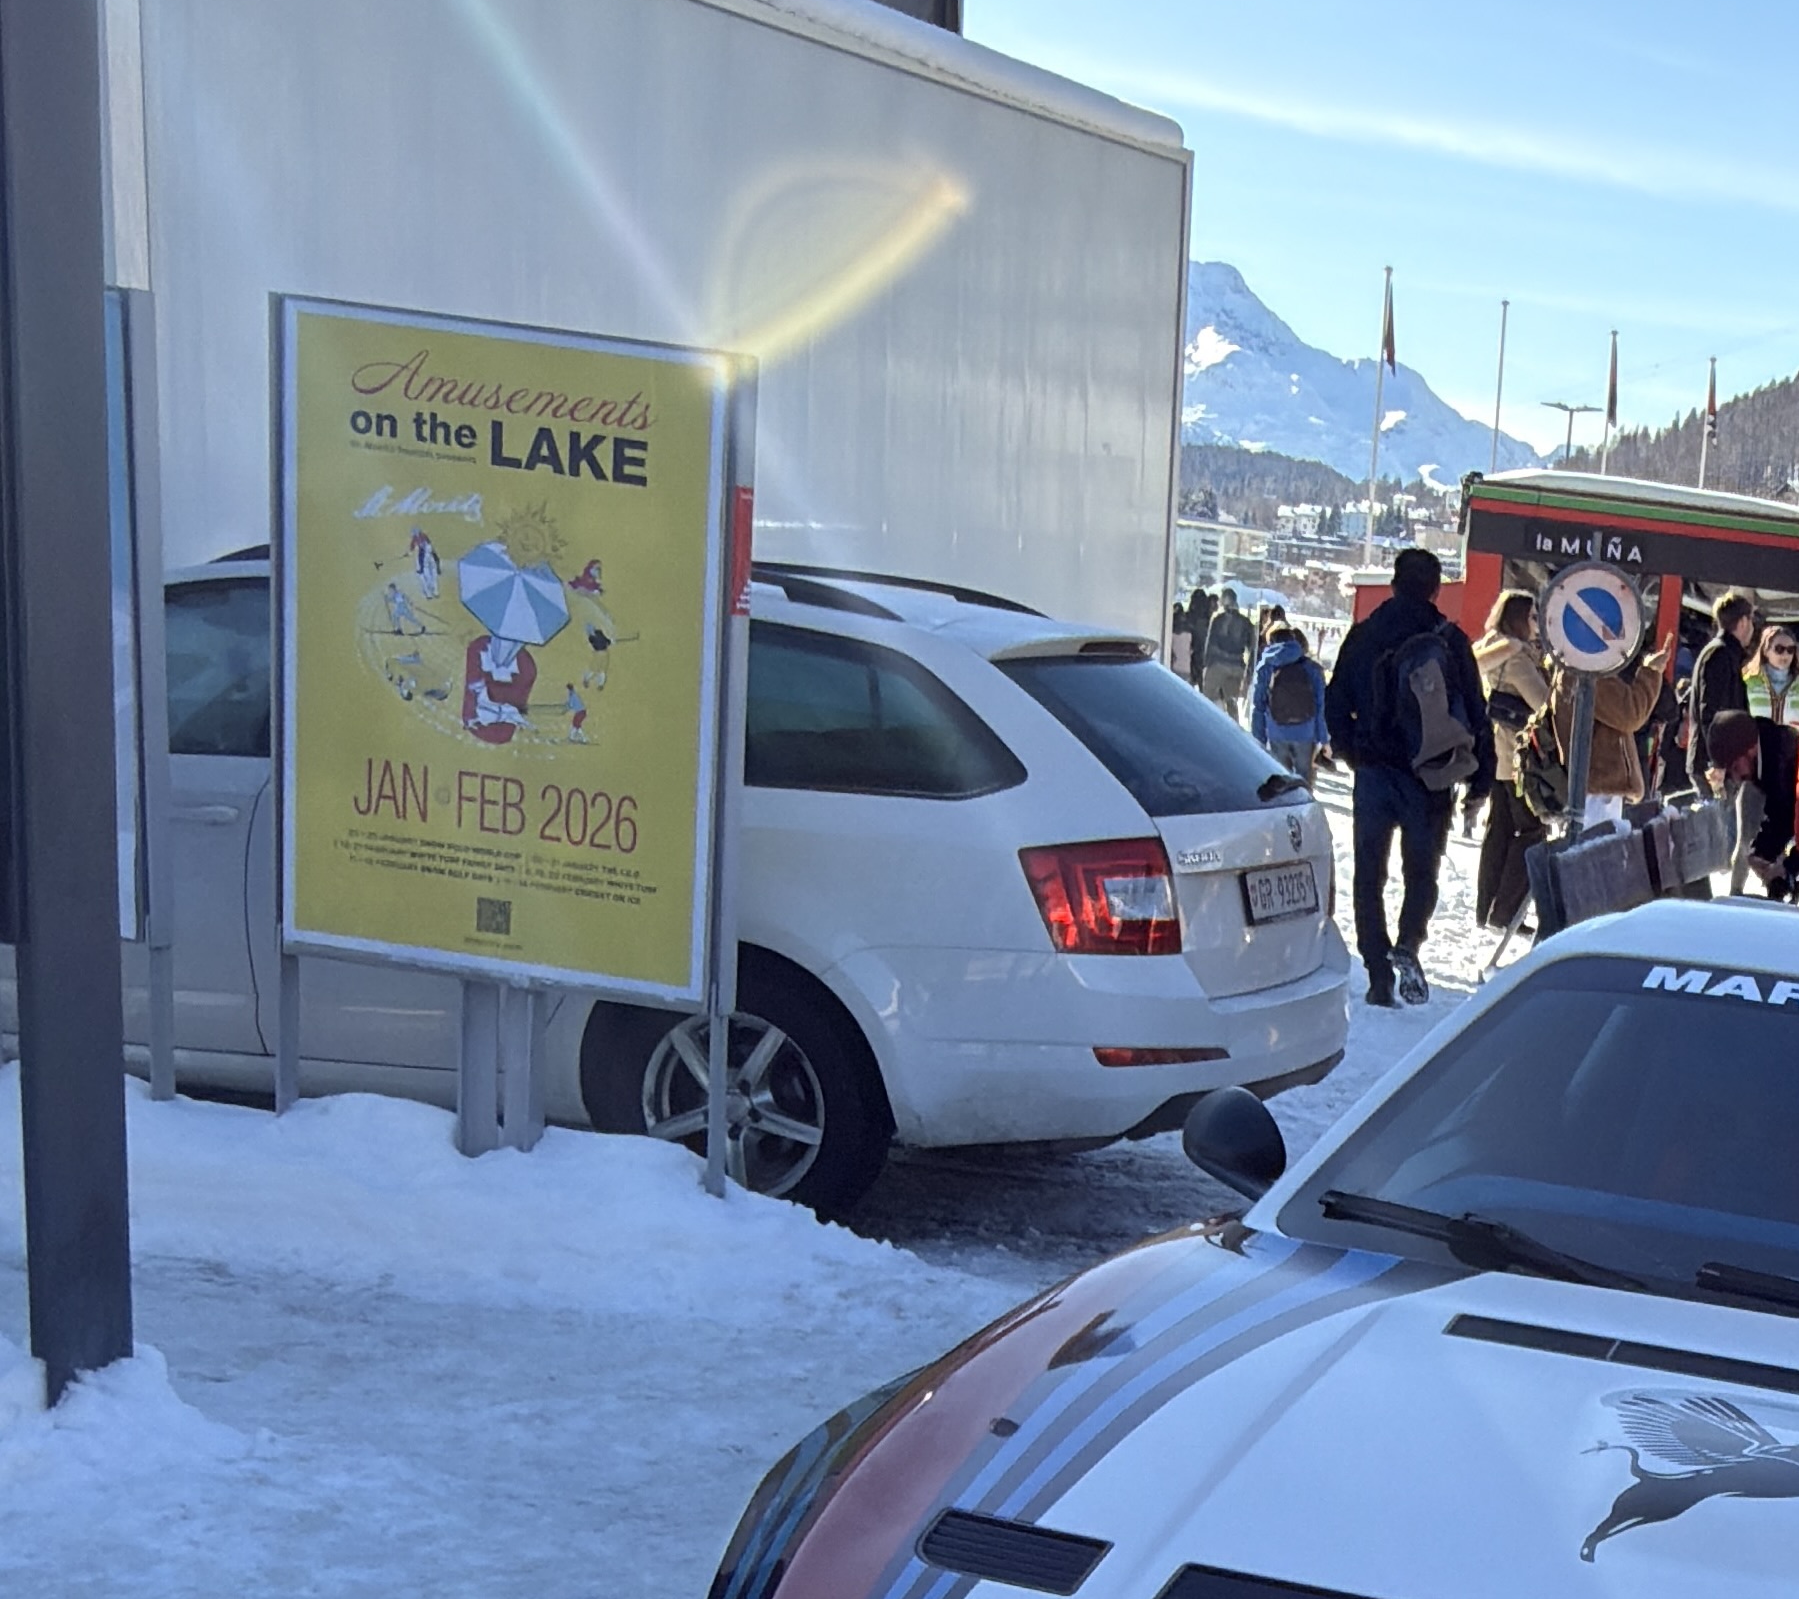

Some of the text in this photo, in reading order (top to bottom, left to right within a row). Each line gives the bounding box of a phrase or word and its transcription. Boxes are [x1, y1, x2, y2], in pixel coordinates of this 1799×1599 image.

[351, 349, 655, 431] Amusements
[350, 409, 398, 439] on
[413, 411, 478, 449] the
[490, 419, 649, 488] LAKE
[1535, 532, 1553, 551] la
[353, 758, 429, 823] JAN
[456, 770, 527, 836] FEB
[538, 784, 639, 854] 2026
